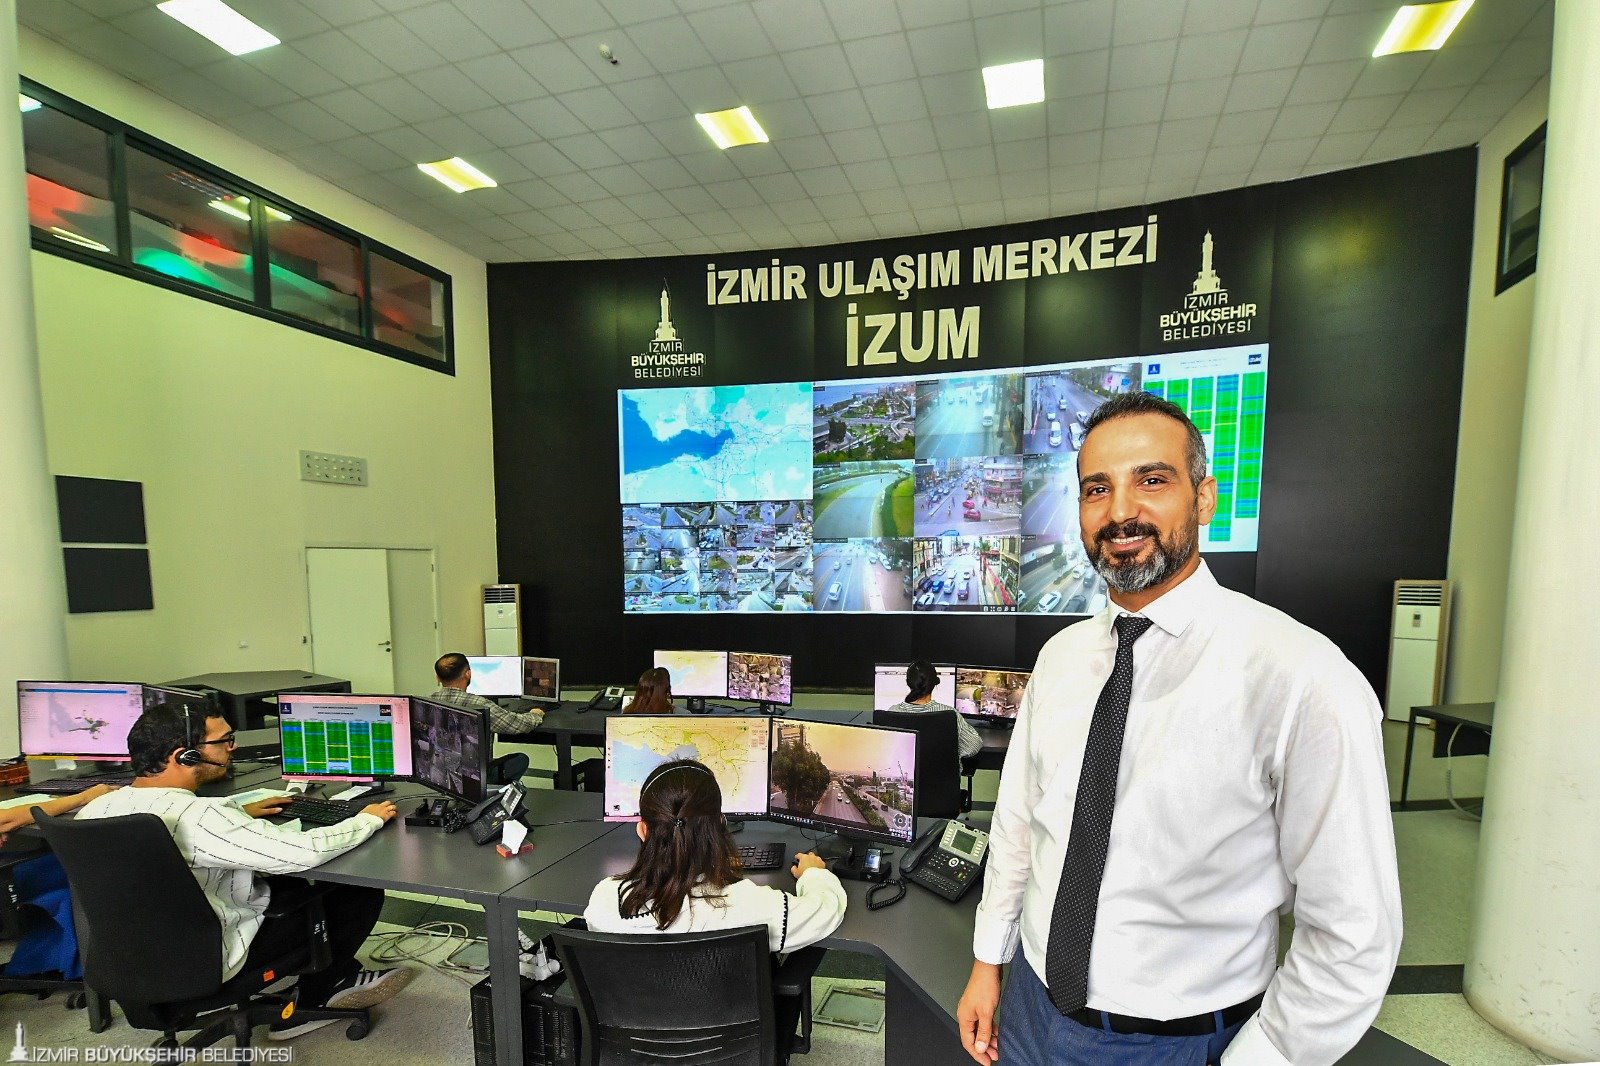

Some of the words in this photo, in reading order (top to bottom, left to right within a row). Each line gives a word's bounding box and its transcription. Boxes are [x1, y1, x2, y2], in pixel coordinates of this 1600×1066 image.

[707, 258, 807, 305] İZMİR
[818, 249, 960, 300] ULAŞIM
[973, 214, 1158, 284] MERKEZİ
[1160, 303, 1257, 328] BÜYÜKŞEHİR
[846, 302, 980, 366] İZUM
[1163, 319, 1251, 341] BELEDİYESİ
[631, 352, 704, 367] BÜYÜKŞEHİR
[634, 366, 701, 378] BELEDİYESİ
